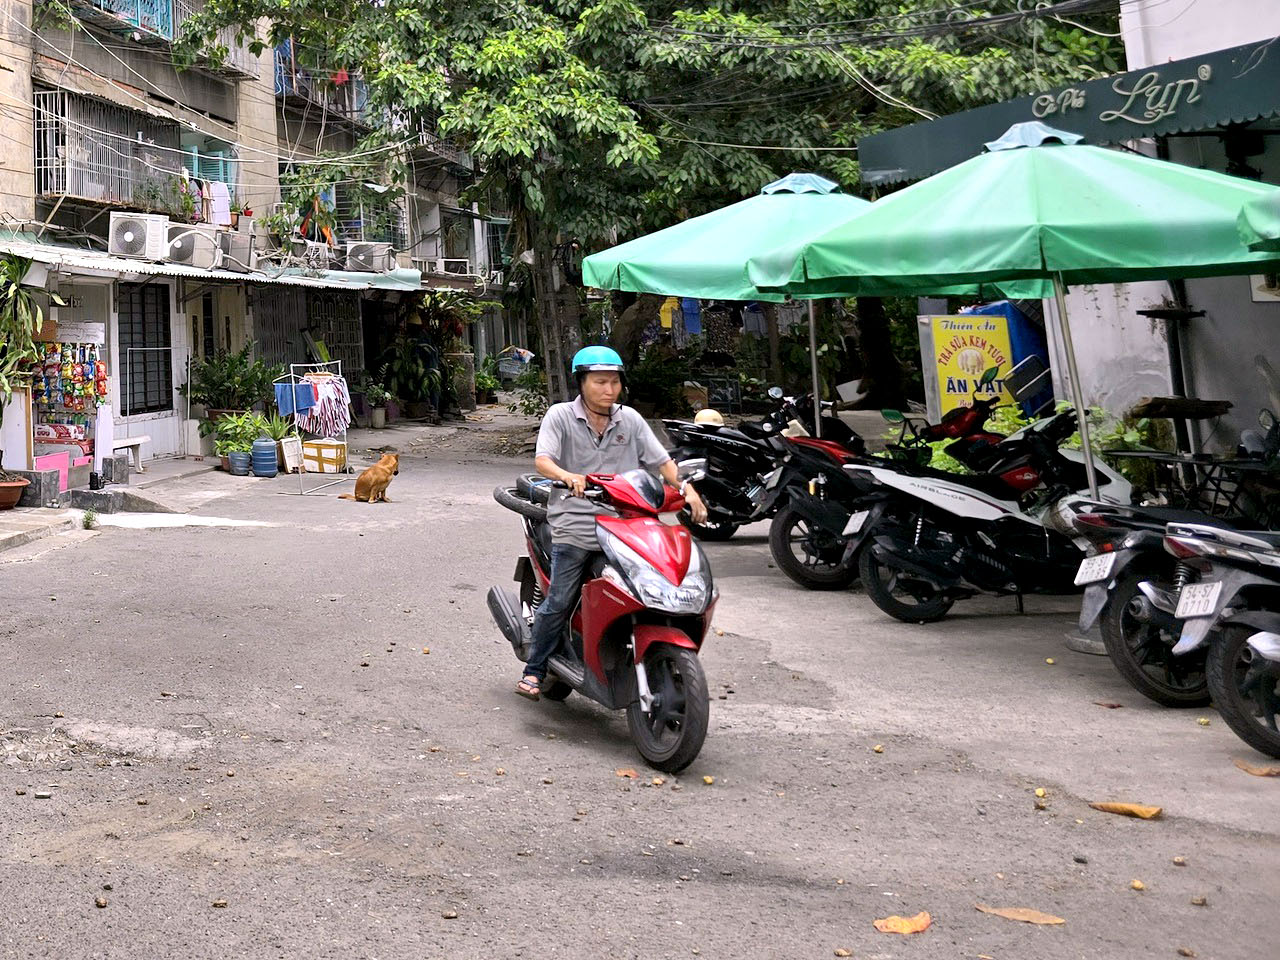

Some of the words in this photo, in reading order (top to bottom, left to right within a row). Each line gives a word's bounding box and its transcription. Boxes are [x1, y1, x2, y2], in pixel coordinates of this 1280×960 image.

[969, 335, 987, 350] KEM
[946, 376, 968, 393] ĂN
[1181, 599, 1210, 615] 0710
